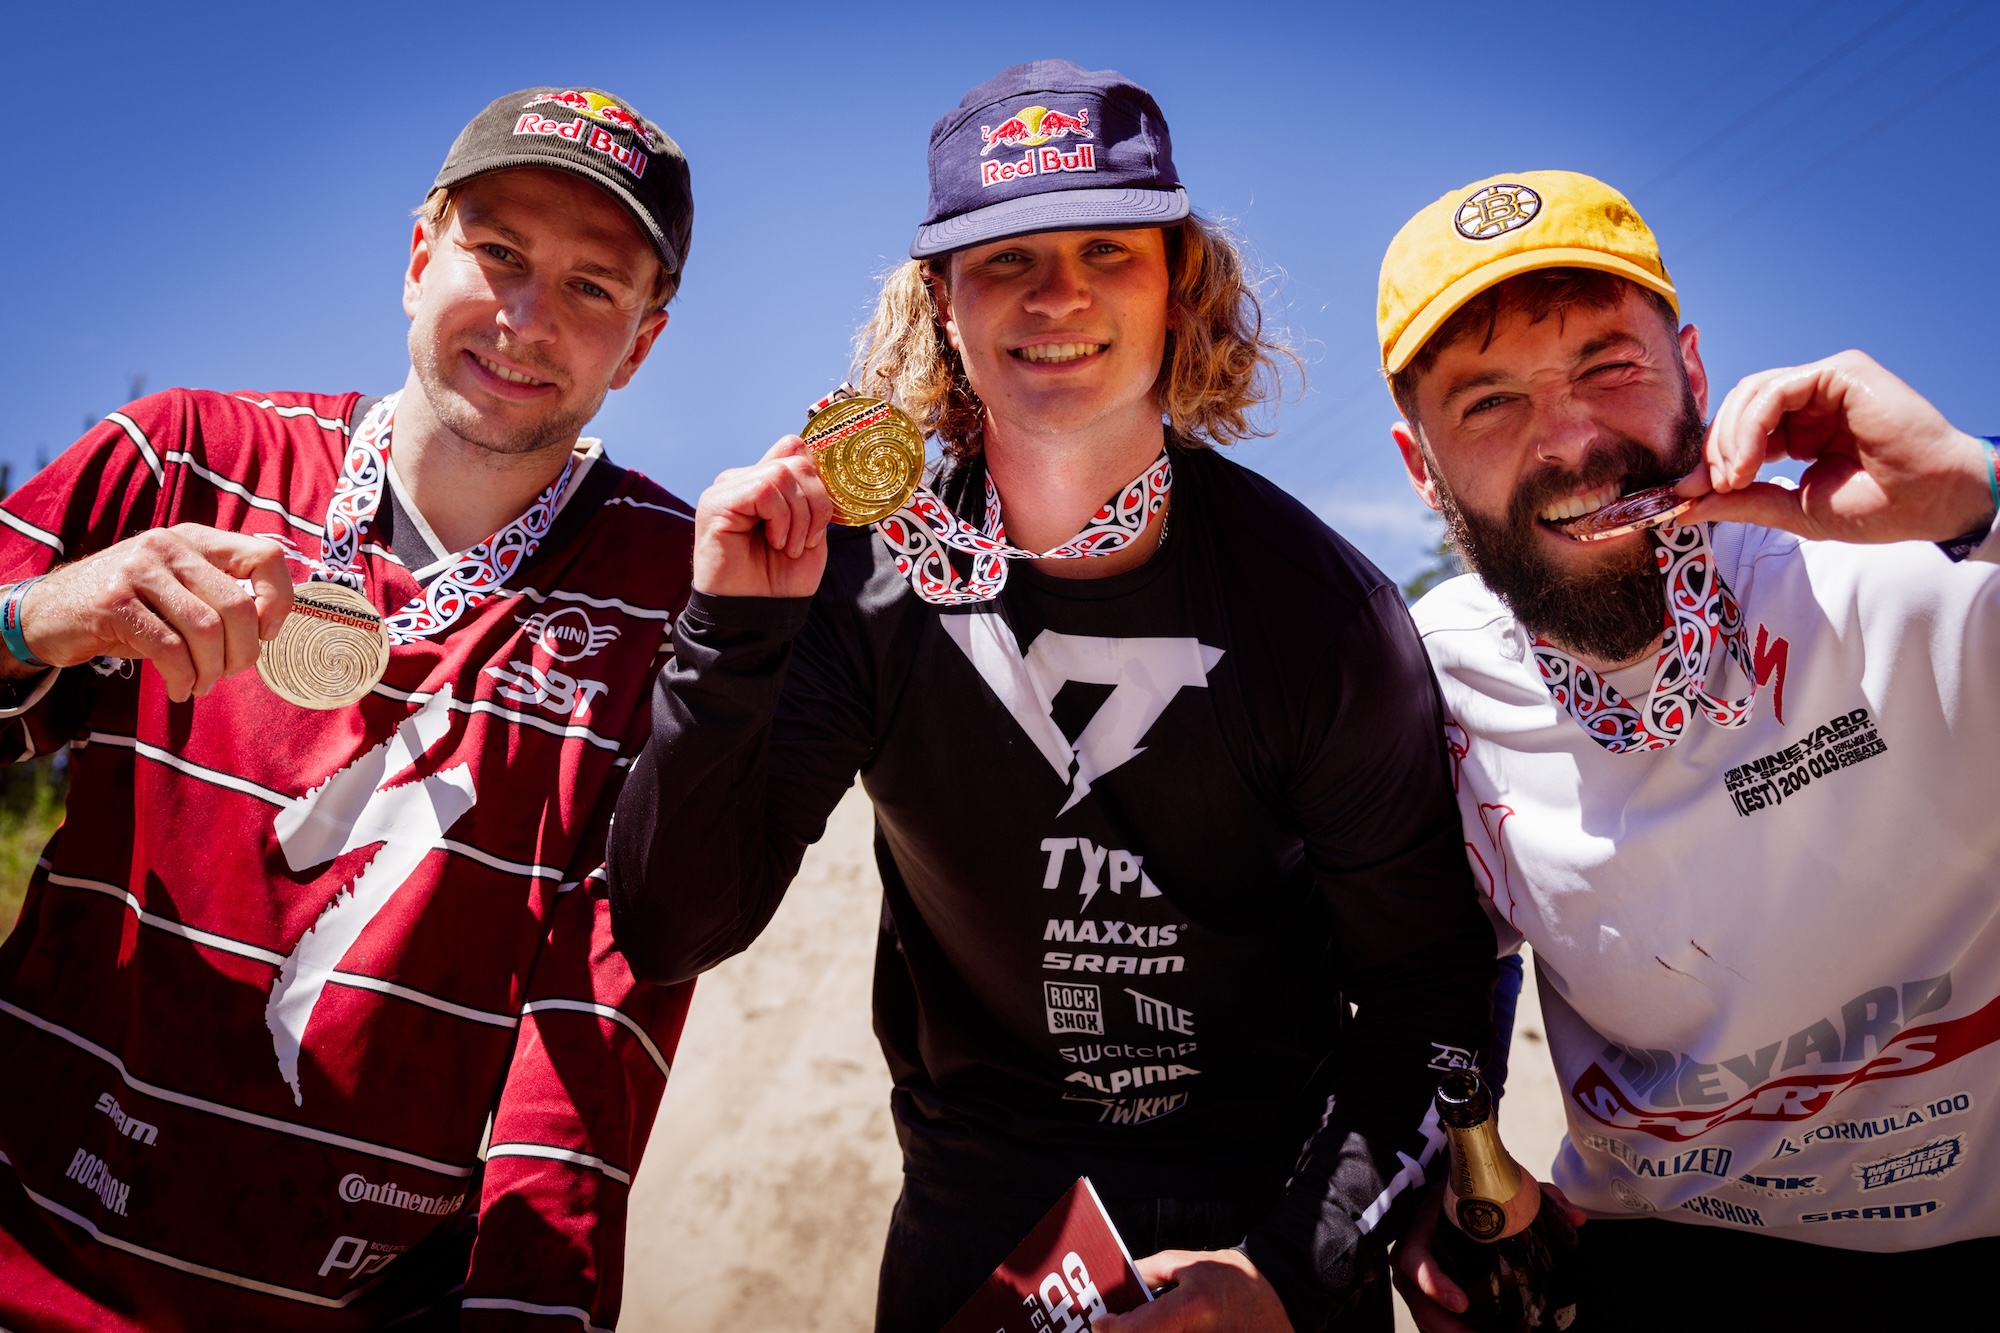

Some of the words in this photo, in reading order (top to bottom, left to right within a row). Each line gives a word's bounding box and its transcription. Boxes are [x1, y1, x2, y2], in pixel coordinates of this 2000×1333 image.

[514, 114, 587, 142] Red
[587, 125, 648, 179] Bull
[981, 149, 1037, 187] Red
[1039, 144, 1096, 174] Bull
[1474, 192, 1520, 229] B
[547, 625, 587, 645] MINI
[1741, 708, 1868, 777] NINEYARD
[1760, 740, 1826, 780] SPORTS
[1827, 719, 1874, 744] DEPT.
[1838, 738, 1887, 763] CREATE
[1778, 765, 1811, 798] 200
[1808, 748, 1840, 779] 019
[1042, 952, 1185, 975] SRAM
[1050, 986, 1096, 1010] ROCK
[1053, 1011, 1099, 1032] SHOX
[1064, 1064, 1202, 1094] ALPINA
[1803, 1111, 1924, 1144] FORMULA
[1927, 1094, 1970, 1118] 100
[1455, 1142, 1474, 1195] LINDAUER
[1867, 1142, 1955, 1177] MASTERS
[1893, 1150, 1954, 1181] DIRT
[1802, 1201, 1938, 1223] SRAM
